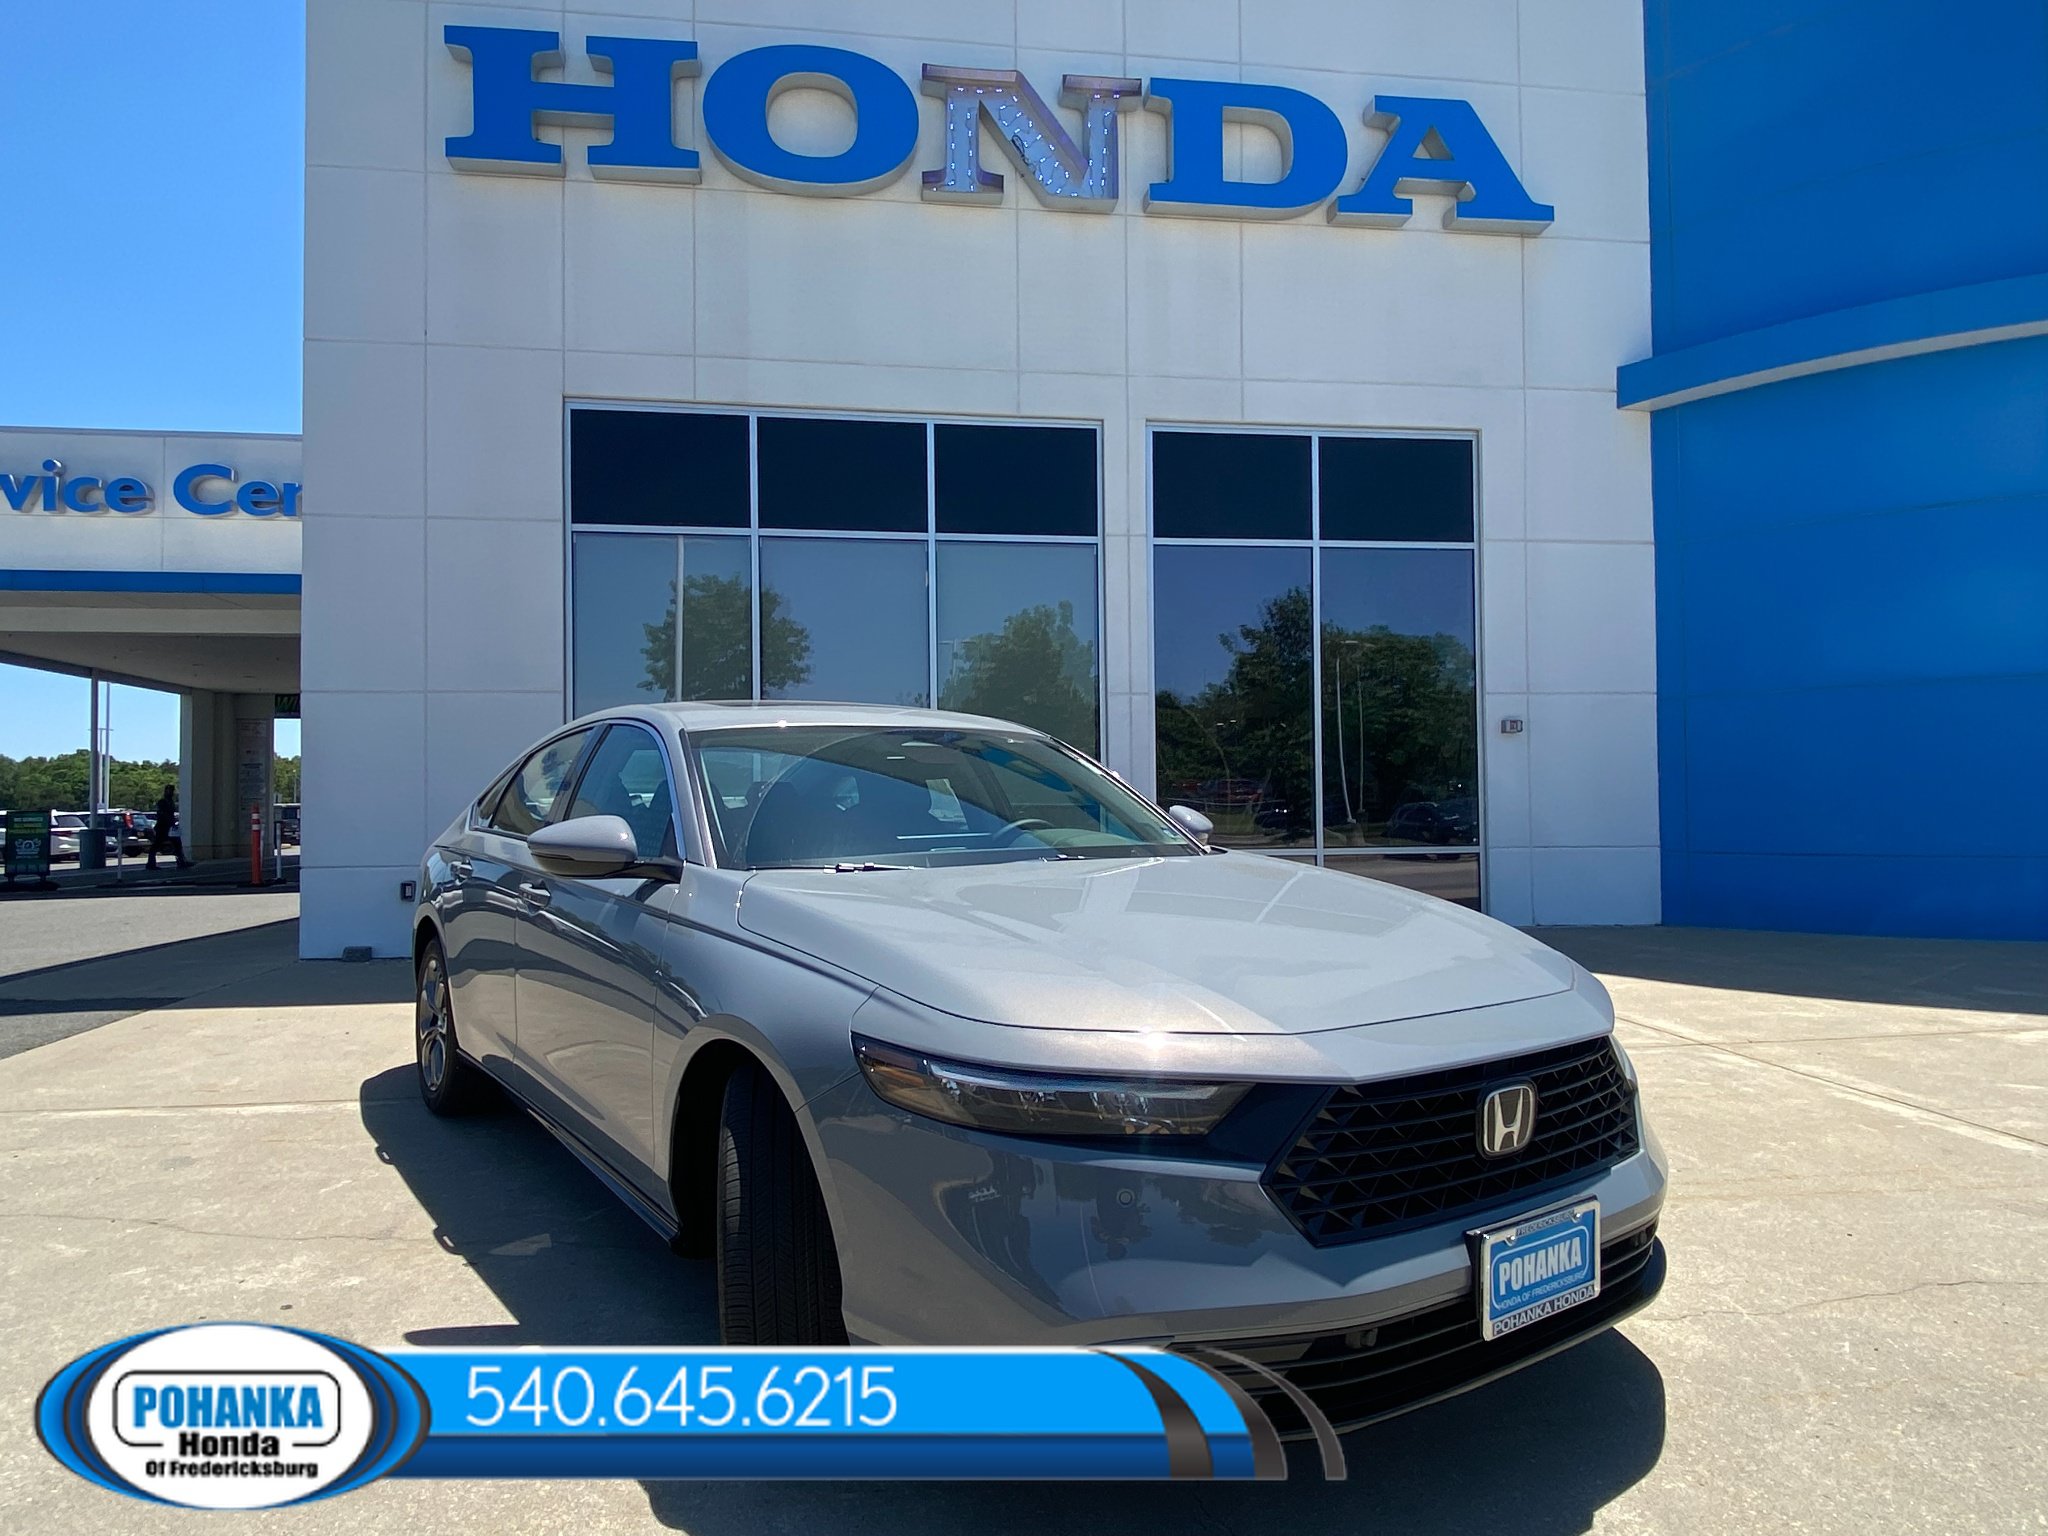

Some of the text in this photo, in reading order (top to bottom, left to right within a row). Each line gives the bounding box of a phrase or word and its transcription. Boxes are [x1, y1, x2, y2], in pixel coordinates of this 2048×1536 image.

[444, 25, 1554, 234] HONDA
[1498, 1236, 1582, 1296] POHANKA
[1493, 1285, 1595, 1336] POHANKA HONDA
[1498, 1295, 1521, 1310] HONDA
[1522, 1289, 1532, 1301] OF
